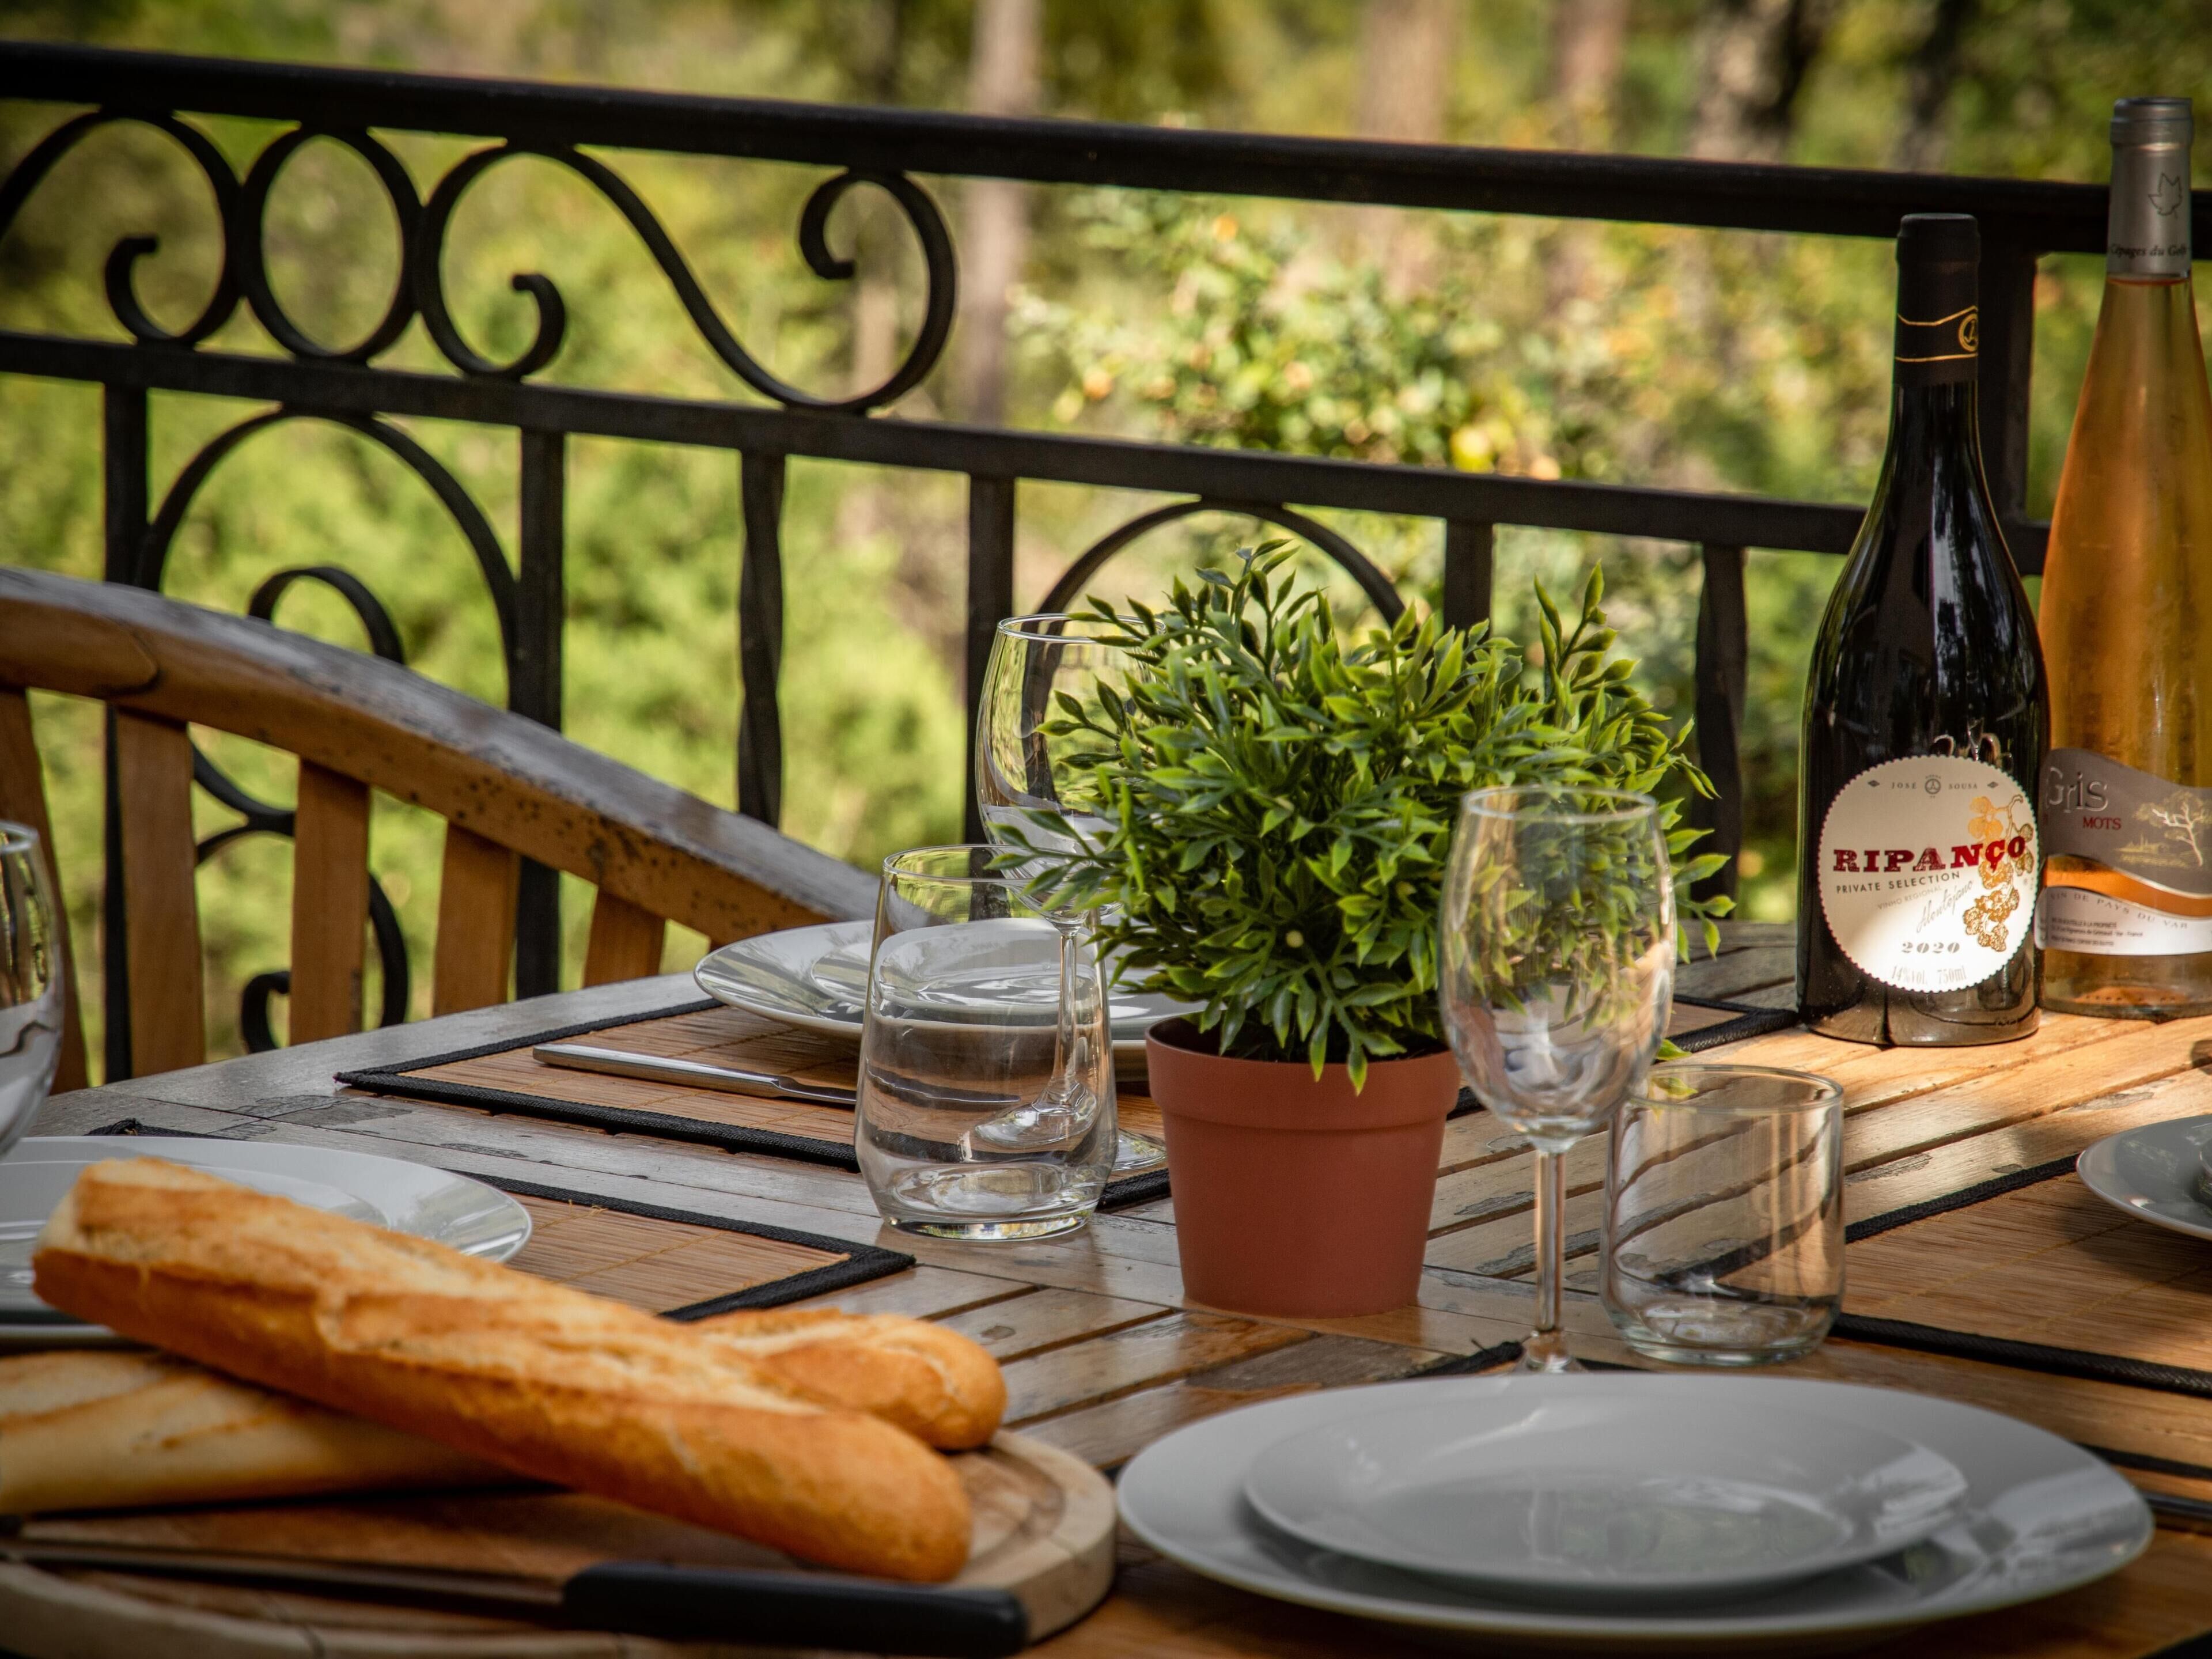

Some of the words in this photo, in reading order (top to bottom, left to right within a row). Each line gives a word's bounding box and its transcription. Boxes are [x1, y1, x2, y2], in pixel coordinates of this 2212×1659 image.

[2150, 245, 2164, 256] du
[2045, 766, 2108, 813] Gris
[2082, 816, 2122, 830] MOTS
[1833, 836, 2025, 872] RIPANÇO
[1836, 882, 1881, 894] PRIVATE
[1889, 871, 1960, 889] SELECTION
[1877, 899, 1902, 910] VINHO
[1904, 886, 1943, 903] REGIONAL
[2050, 892, 2067, 900] VIN
[2074, 893, 2089, 902] DE
[2097, 896, 2130, 915] PAYS
[2138, 912, 2156, 923] DU
[2164, 919, 2188, 930] VAR
[1902, 941, 1960, 954] 2020
[1937, 964, 1967, 985] 750ml
